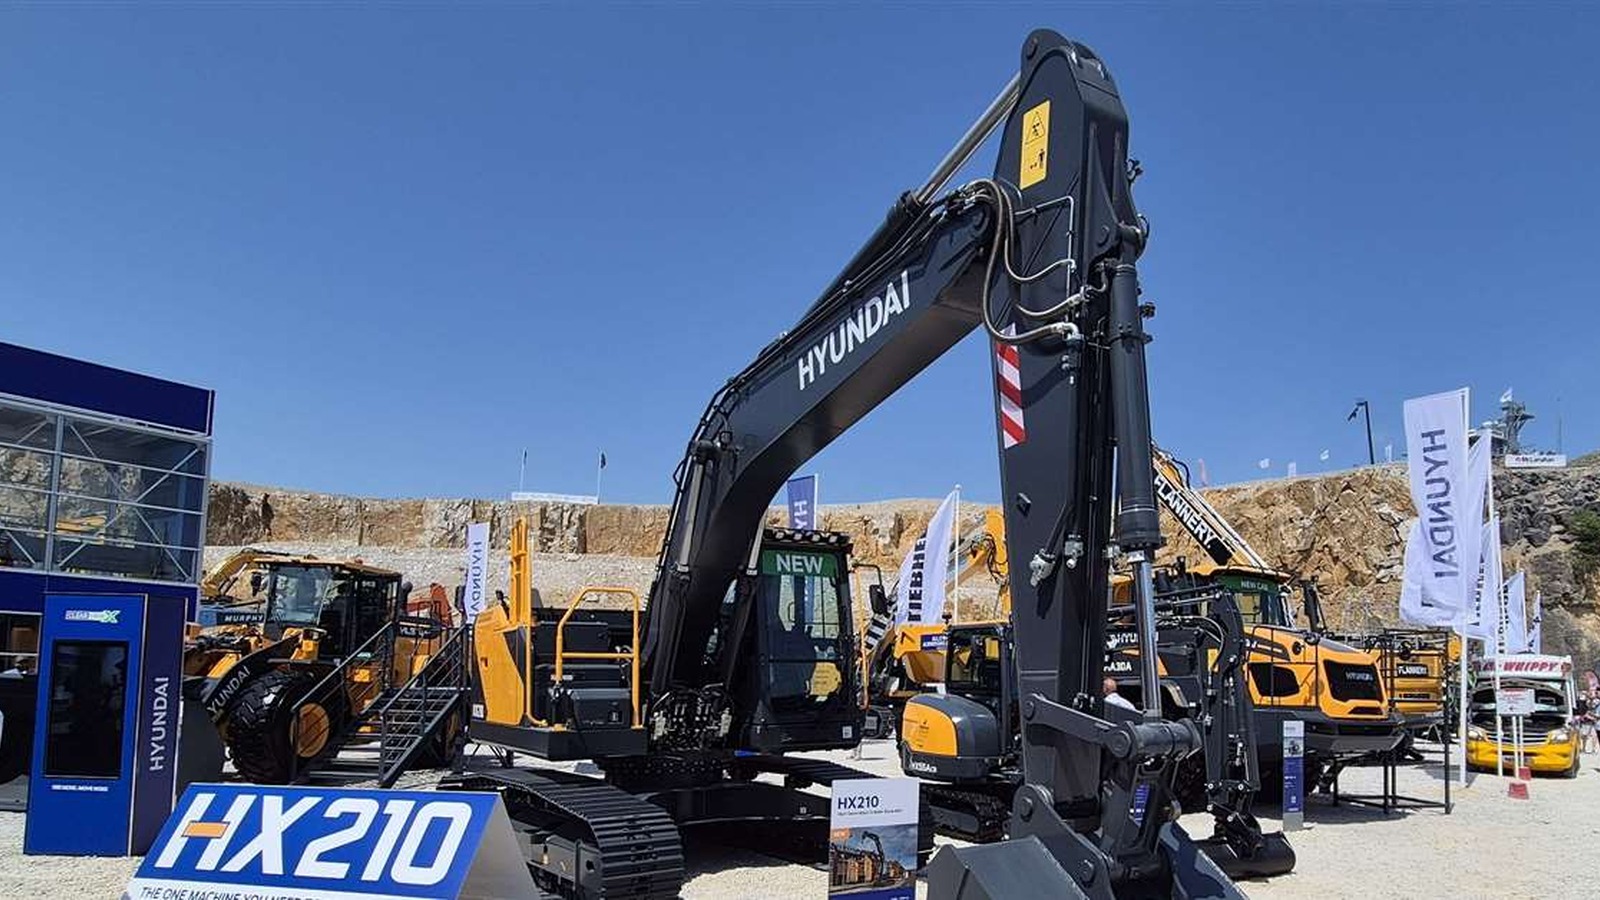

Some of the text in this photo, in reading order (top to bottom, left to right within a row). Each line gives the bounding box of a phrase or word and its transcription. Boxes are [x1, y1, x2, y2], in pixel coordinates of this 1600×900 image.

[797, 270, 911, 391] HYUNDAI
[776, 553, 823, 574] NEW
[224, 613, 264, 622] MURPHY
[206, 665, 250, 721] YUNDAI
[149, 677, 169, 772] HYUNDAI
[837, 796, 879, 809] HX210
[155, 793, 473, 886] HX210
[141, 886, 163, 899] THE
[163, 888, 188, 900] ONE
